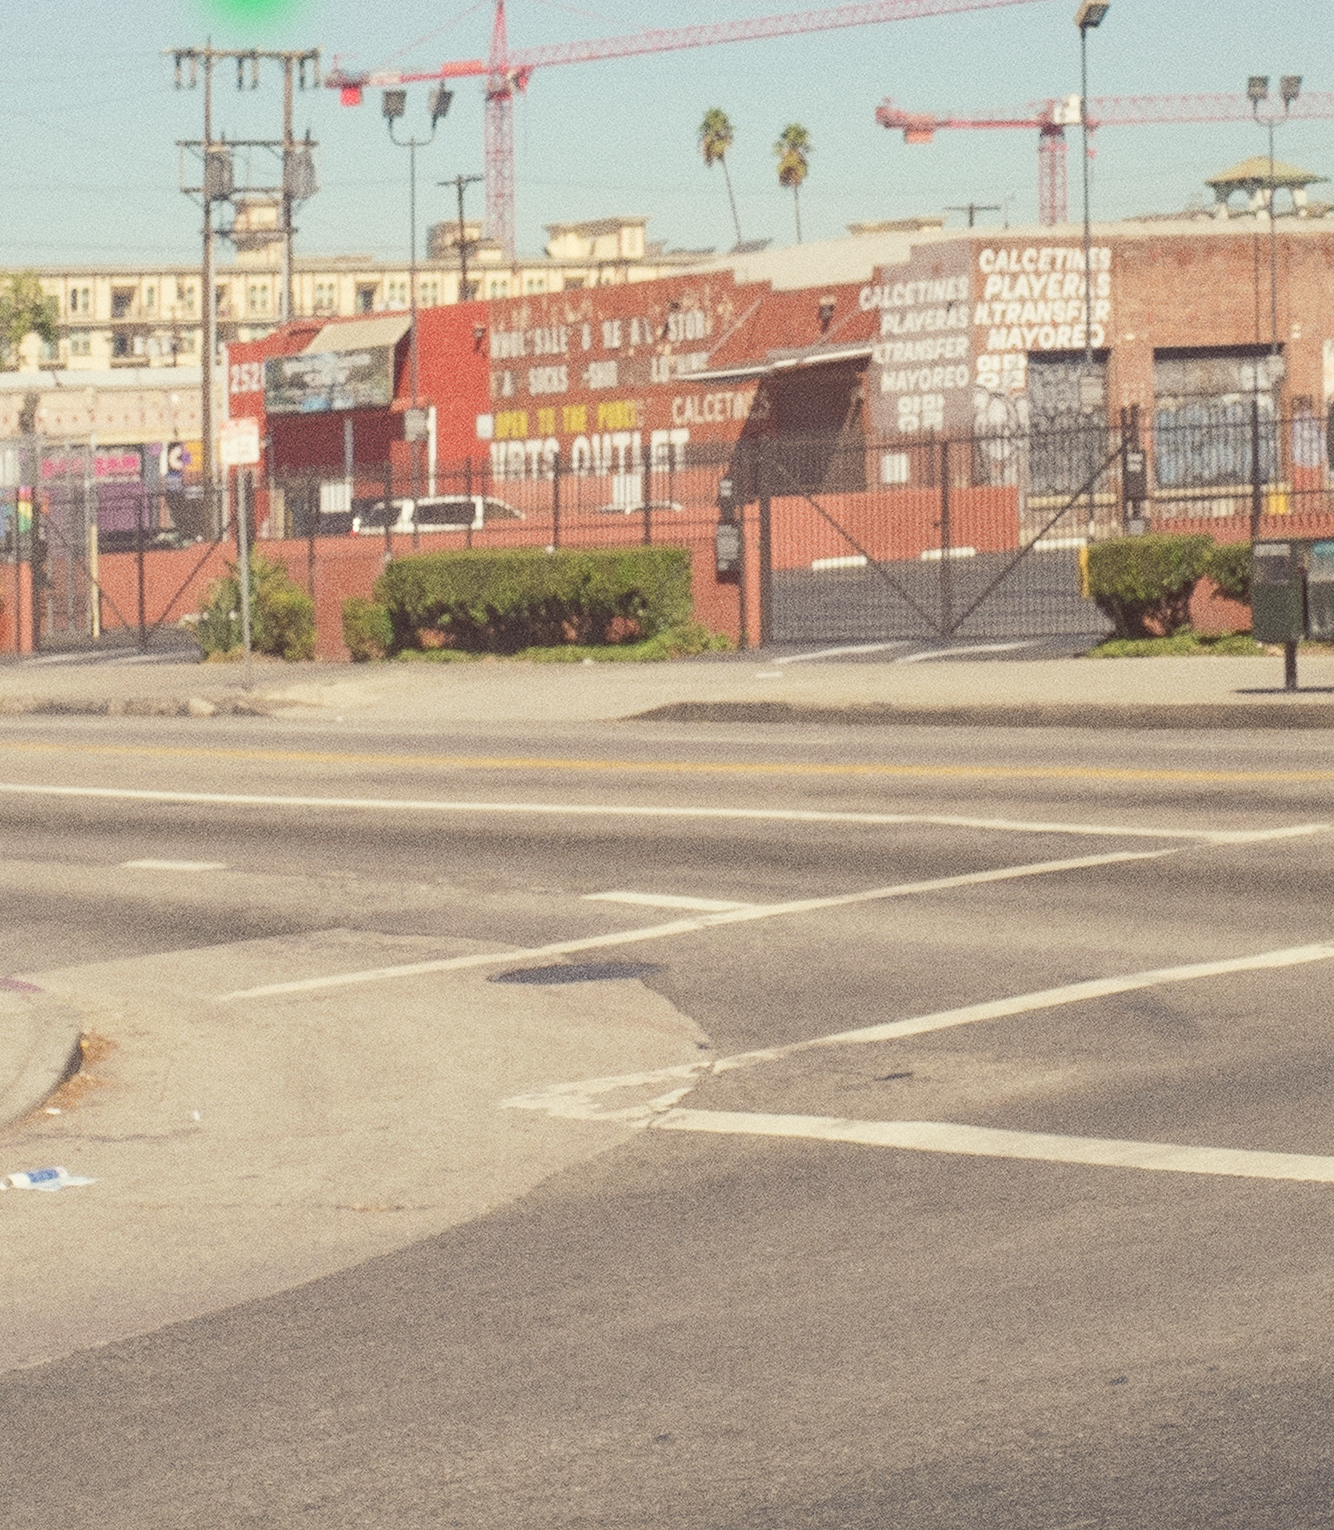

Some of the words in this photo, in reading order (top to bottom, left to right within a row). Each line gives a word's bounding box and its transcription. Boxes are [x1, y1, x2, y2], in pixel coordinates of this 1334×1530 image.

[978, 246, 1113, 273] CALCETINES
[858, 275, 968, 311] CALCETINES
[879, 305, 968, 336] PLAYERAS
[985, 323, 1106, 352] MAYOREO
[880, 364, 969, 393] MAYOREO
[571, 426, 691, 478] OUTLET
